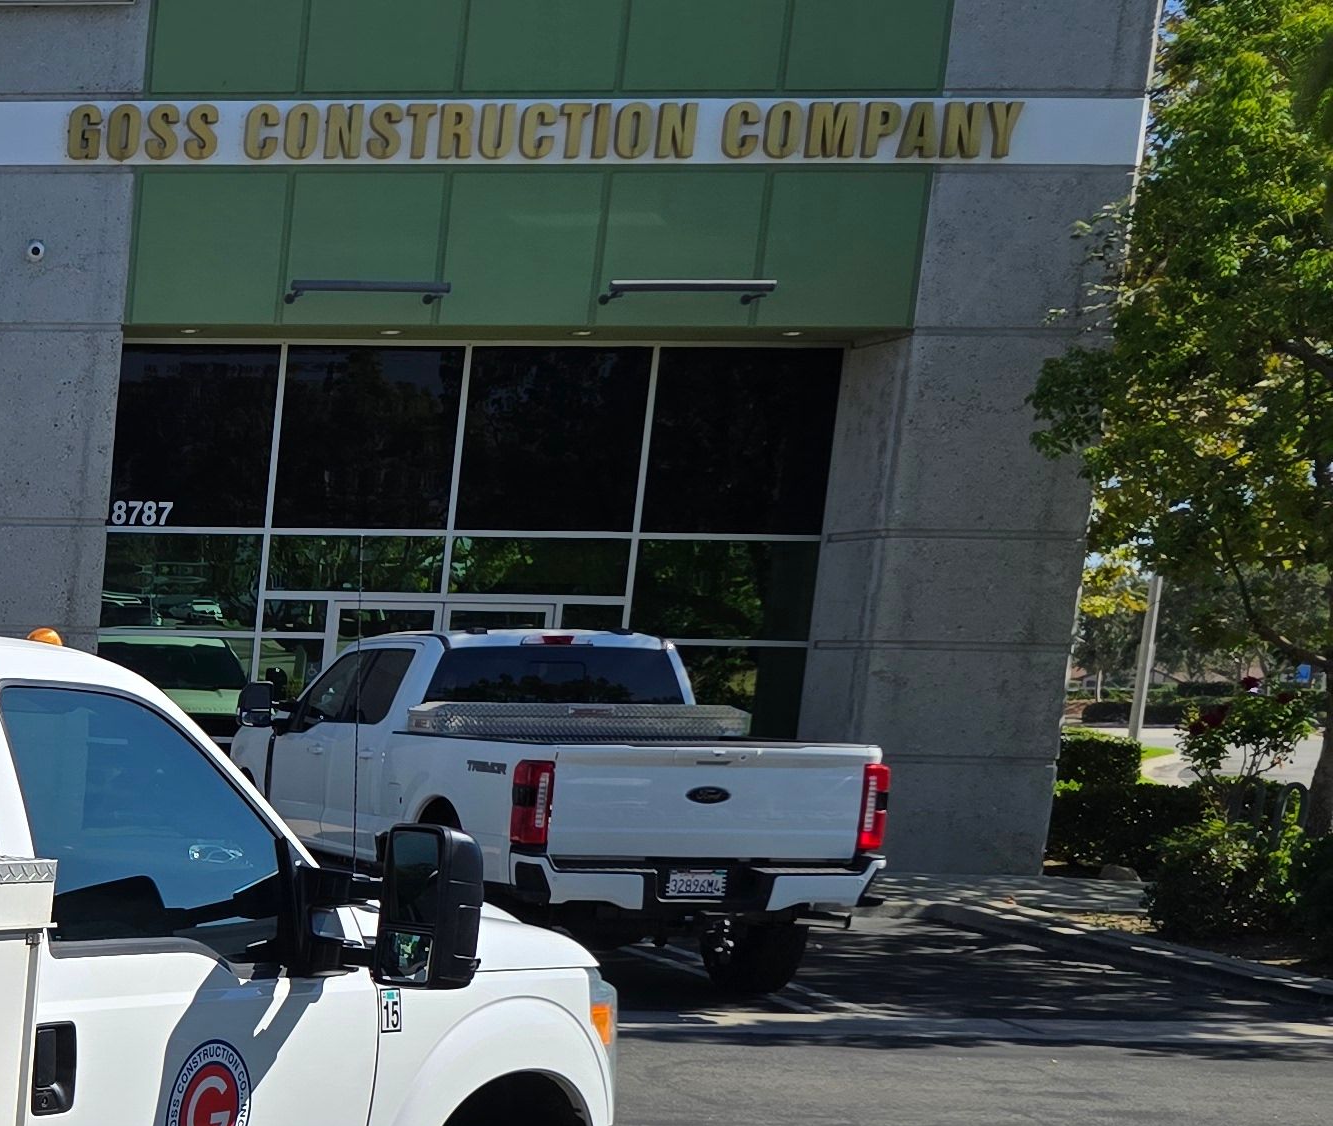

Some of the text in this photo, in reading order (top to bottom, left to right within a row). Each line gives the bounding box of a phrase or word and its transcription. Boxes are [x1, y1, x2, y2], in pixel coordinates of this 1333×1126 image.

[67, 100, 1025, 160] GOSS CONSTRUCTION COMPANY
[112, 501, 173, 526] 8787
[383, 1000, 400, 1029] 15
[177, 1045, 240, 1095] CONSTRUCTION
